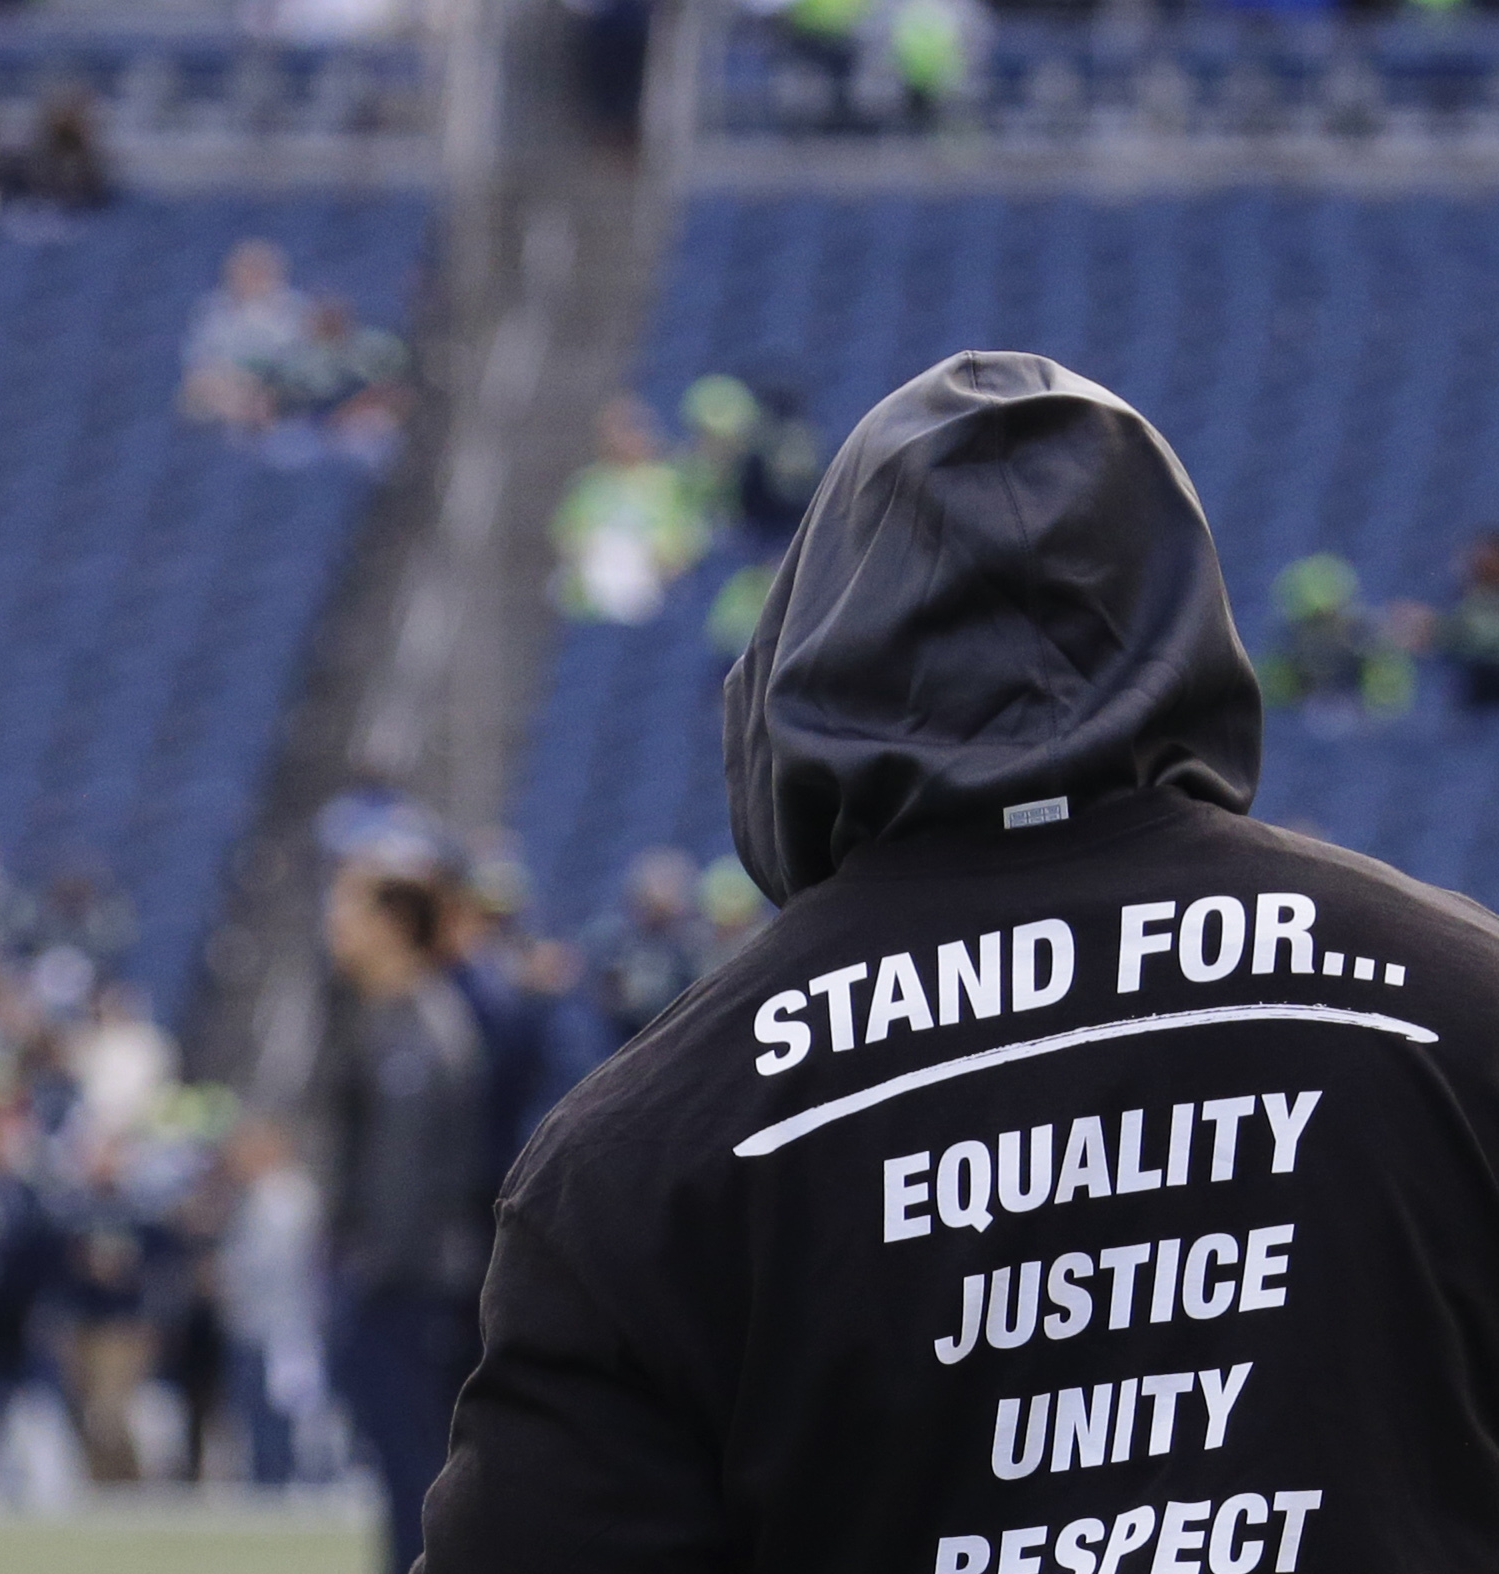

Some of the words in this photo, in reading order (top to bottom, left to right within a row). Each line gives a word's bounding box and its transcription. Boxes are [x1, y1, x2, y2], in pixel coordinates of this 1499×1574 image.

[753, 917, 1076, 1077] STAND
[1117, 891, 1407, 995] FOR...
[883, 1089, 1324, 1244] EQUALITY
[933, 1223, 1295, 1365] JUSTICE
[991, 1361, 1254, 1481] UNITY
